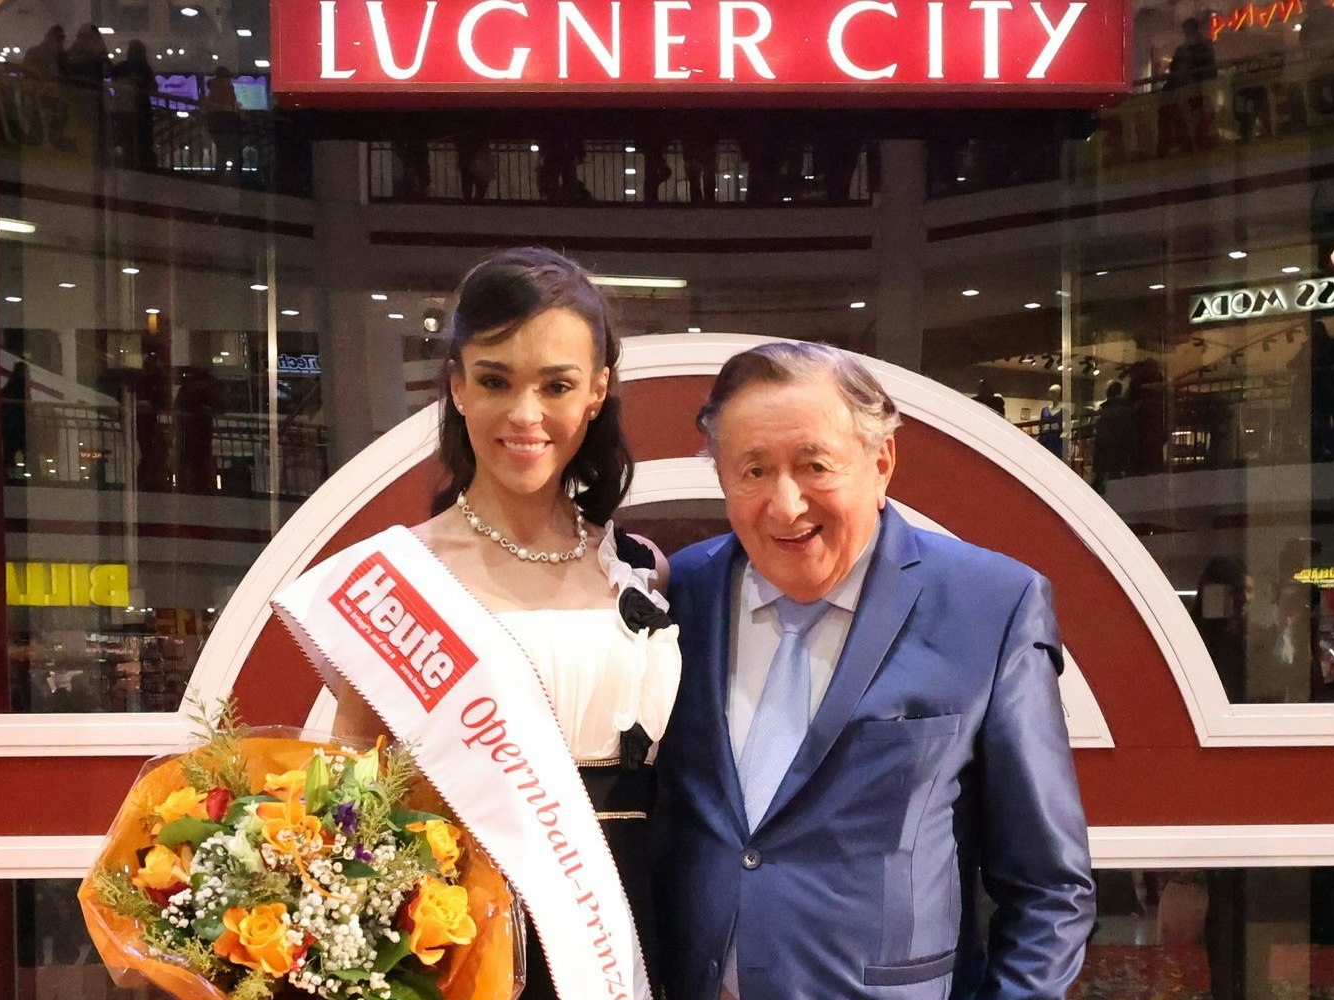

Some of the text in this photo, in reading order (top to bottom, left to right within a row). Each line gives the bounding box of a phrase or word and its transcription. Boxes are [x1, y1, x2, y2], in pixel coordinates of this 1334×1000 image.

[319, 1, 1085, 79] LUGNER CITY
[344, 563, 455, 690] Heute
